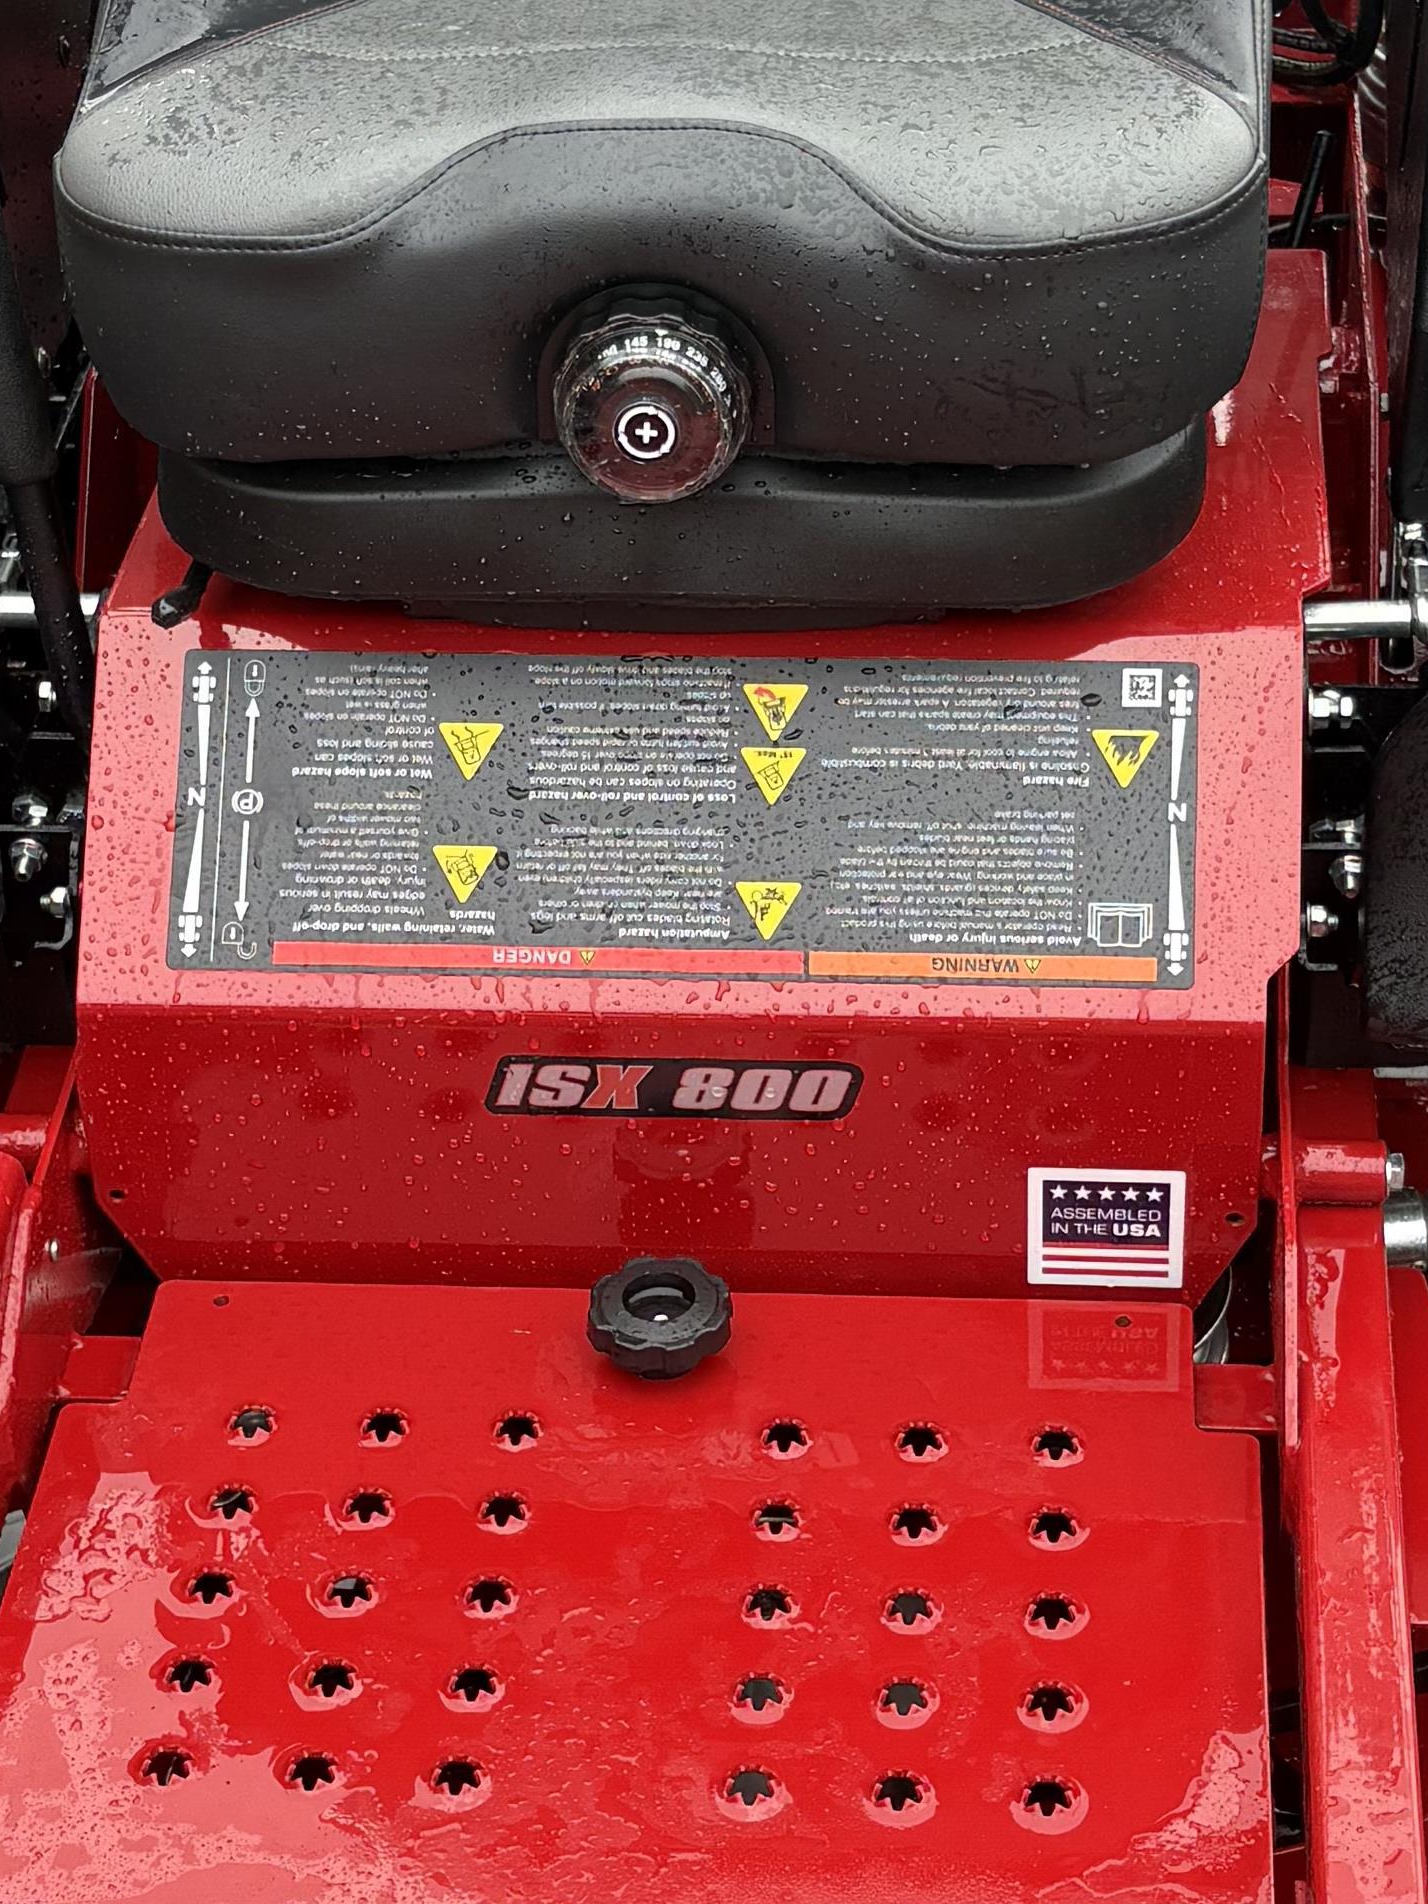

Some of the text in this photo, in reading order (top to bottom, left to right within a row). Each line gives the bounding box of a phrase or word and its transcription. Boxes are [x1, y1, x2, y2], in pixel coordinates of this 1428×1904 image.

[292, 767, 331, 777] hazard
[334, 765, 366, 777] slope
[369, 768, 391, 778] soft
[409, 768, 432, 778] Wet
[1023, 776, 1089, 787] Fire hazard
[188, 787, 206, 806] N
[529, 791, 568, 801] hazard
[571, 792, 619, 801] roll-over
[622, 792, 645, 802] and
[648, 793, 689, 802] control
[707, 793, 735, 803] Loss
[1168, 802, 1187, 822] N
[292, 920, 495, 934] Water, retaining walls, and drop-off
[619, 927, 730, 938] Amputation hazard
[909, 934, 942, 944] death
[961, 932, 995, 944] injury
[998, 935, 1044, 945] serious
[1047, 936, 1081, 945] Avoid
[493, 948, 571, 964] DANGER
[932, 958, 1018, 972] WARNING
[495, 1064, 854, 1112] ISX 800
[1051, 1208, 1161, 1222] ASSEMBLED
[1052, 1223, 1161, 1237] IN THE USA
